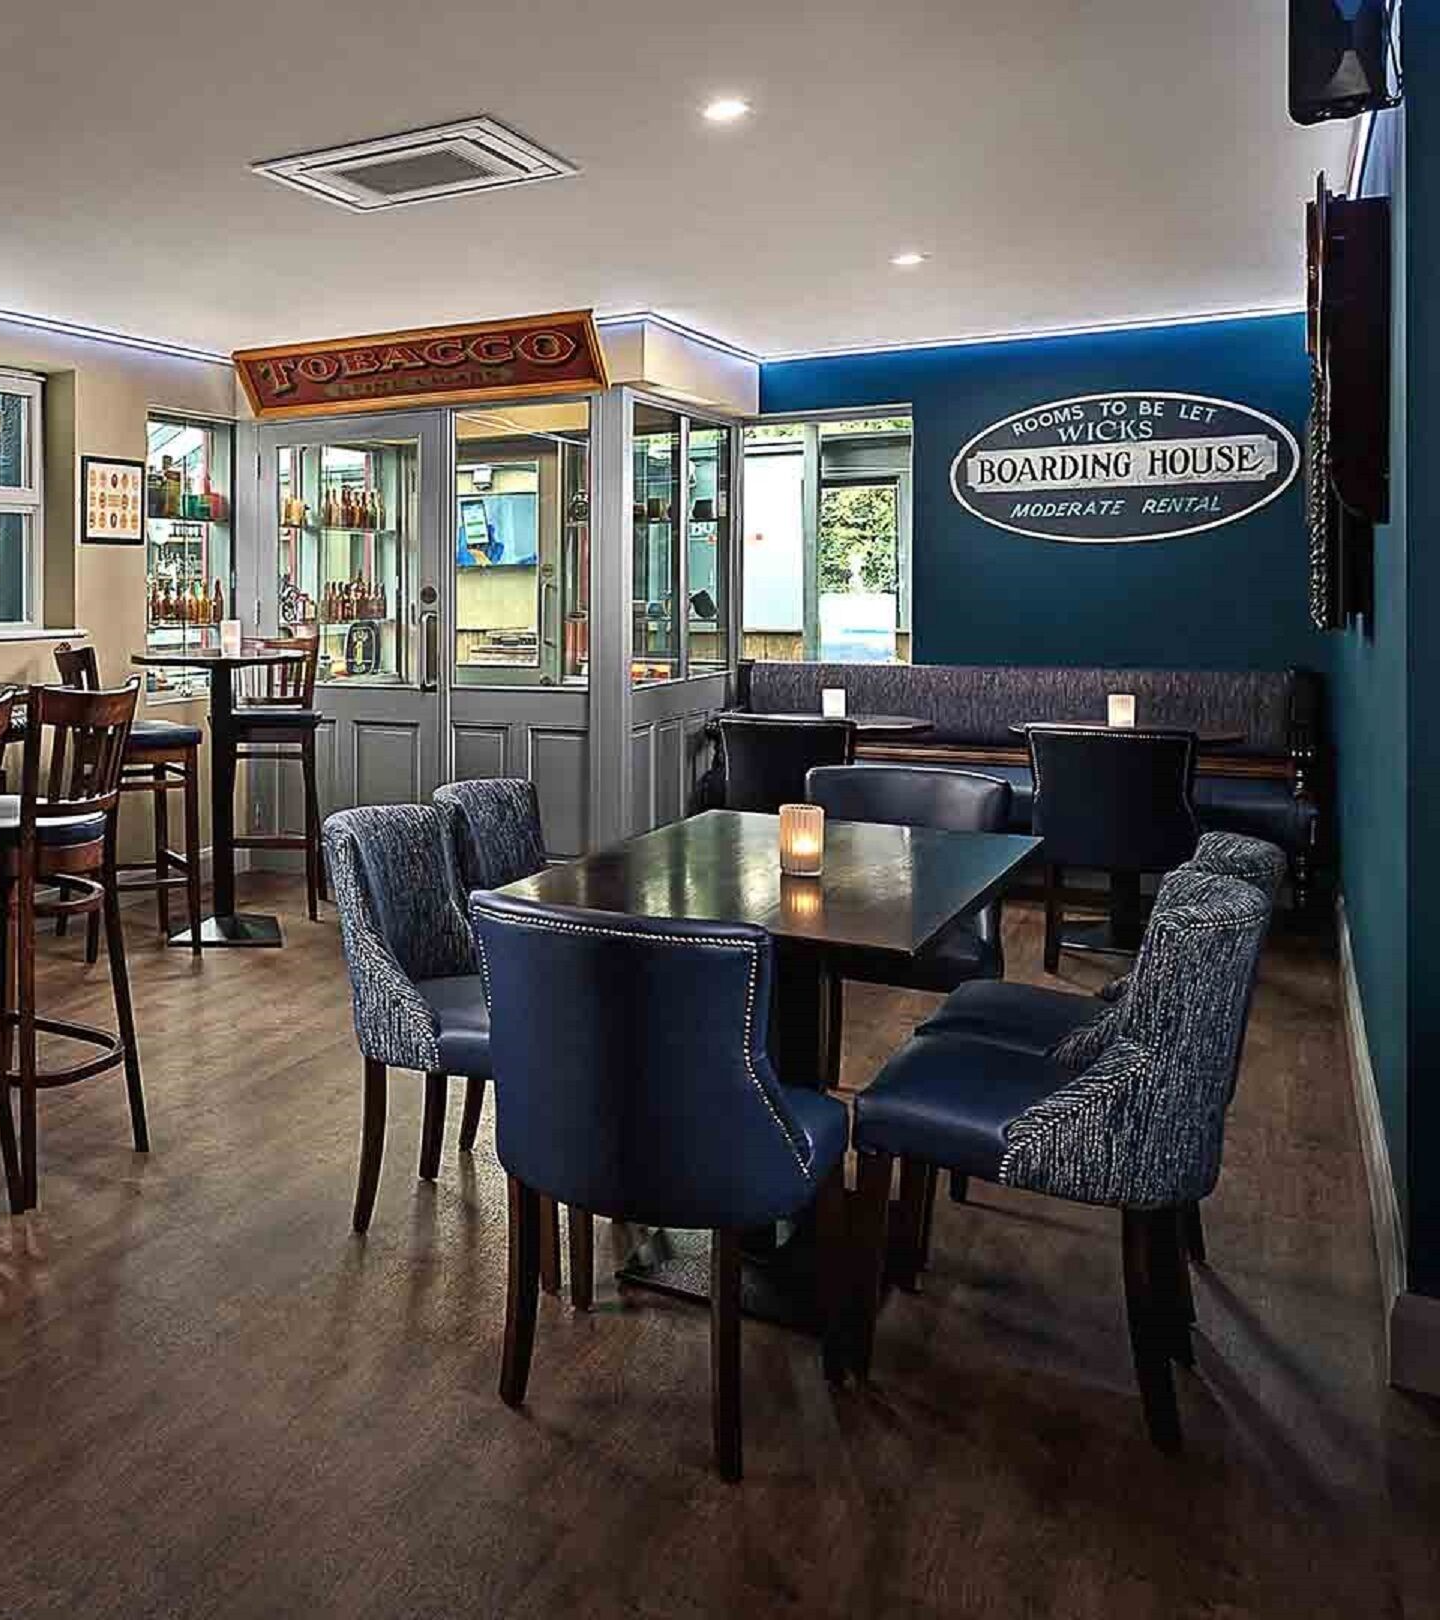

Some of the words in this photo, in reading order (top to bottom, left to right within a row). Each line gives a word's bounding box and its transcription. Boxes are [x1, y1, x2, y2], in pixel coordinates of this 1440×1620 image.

[261, 330, 576, 393] TOBACCO
[1011, 405, 1085, 437] ROOMS
[1099, 401, 1128, 417] TO
[1139, 401, 1165, 417] BE
[1178, 404, 1219, 424] LET
[1057, 419, 1154, 442] WICKS
[978, 451, 1132, 485] BOARDING
[1148, 443, 1265, 476] HOUSE
[1009, 500, 1126, 518] MODERATE
[1141, 496, 1223, 514] RENTAL
